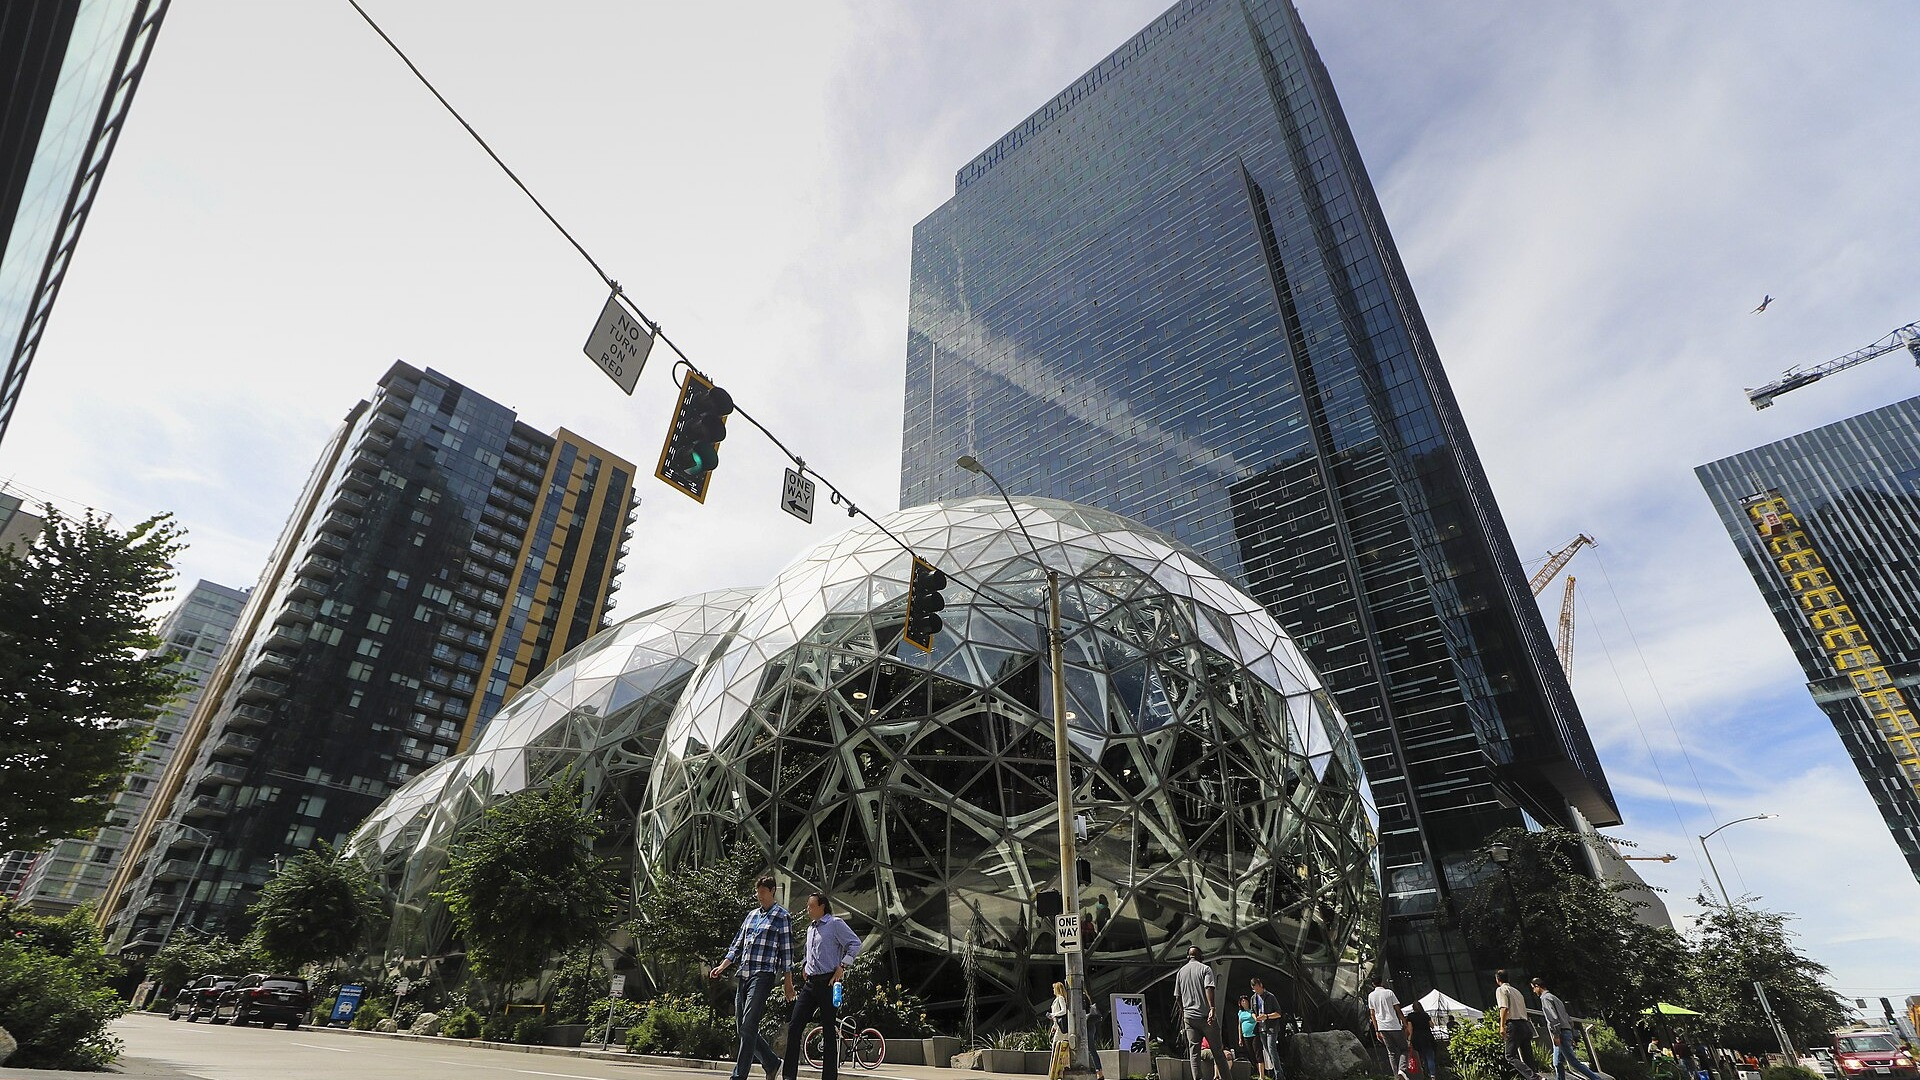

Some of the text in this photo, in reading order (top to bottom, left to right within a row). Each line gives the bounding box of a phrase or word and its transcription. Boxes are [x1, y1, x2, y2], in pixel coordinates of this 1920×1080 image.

[617, 314, 640, 341] NO
[609, 323, 638, 358] TURN
[609, 344, 626, 363] ON
[600, 352, 623, 377] RED
[787, 484, 811, 504] WAY
[789, 474, 811, 494] ONE
[1058, 917, 1078, 927] ONE
[1058, 928, 1079, 938] WAY
